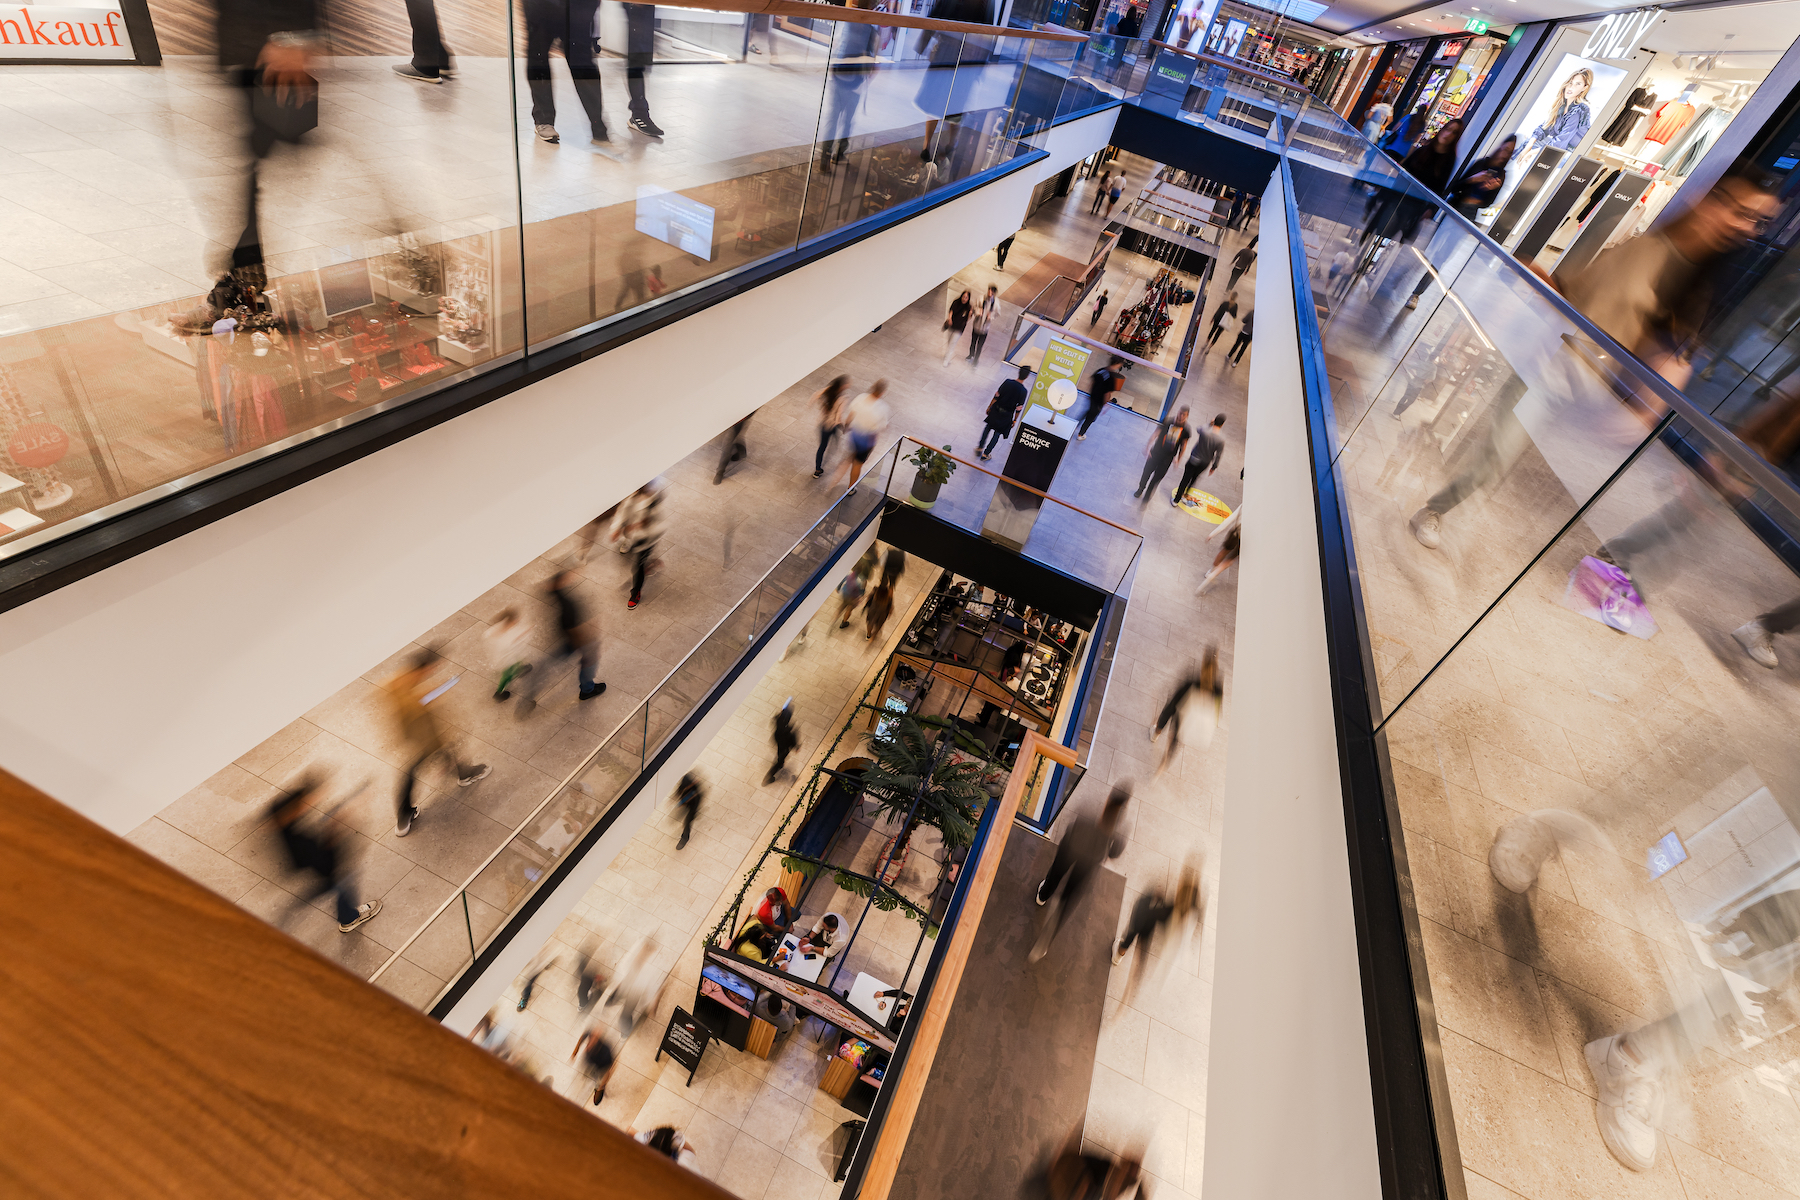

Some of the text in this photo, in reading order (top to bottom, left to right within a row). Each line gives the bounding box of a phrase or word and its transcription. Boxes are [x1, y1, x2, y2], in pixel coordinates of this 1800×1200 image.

[0, 8, 124, 46] nkauf
[1580, 9, 1664, 59] ONLY
[1163, 67, 1187, 81] FORUM
[1441, 103, 1459, 114] SALE
[1537, 162, 1551, 170] ONLY
[1570, 175, 1586, 184] ONLY
[1614, 192, 1633, 202] ONLY
[1049, 343, 1086, 362] HIER GEHT ES
[1055, 354, 1075, 367] WEITER
[1019, 437, 1041, 450] POINT
[1021, 431, 1051, 448] SERVICE
